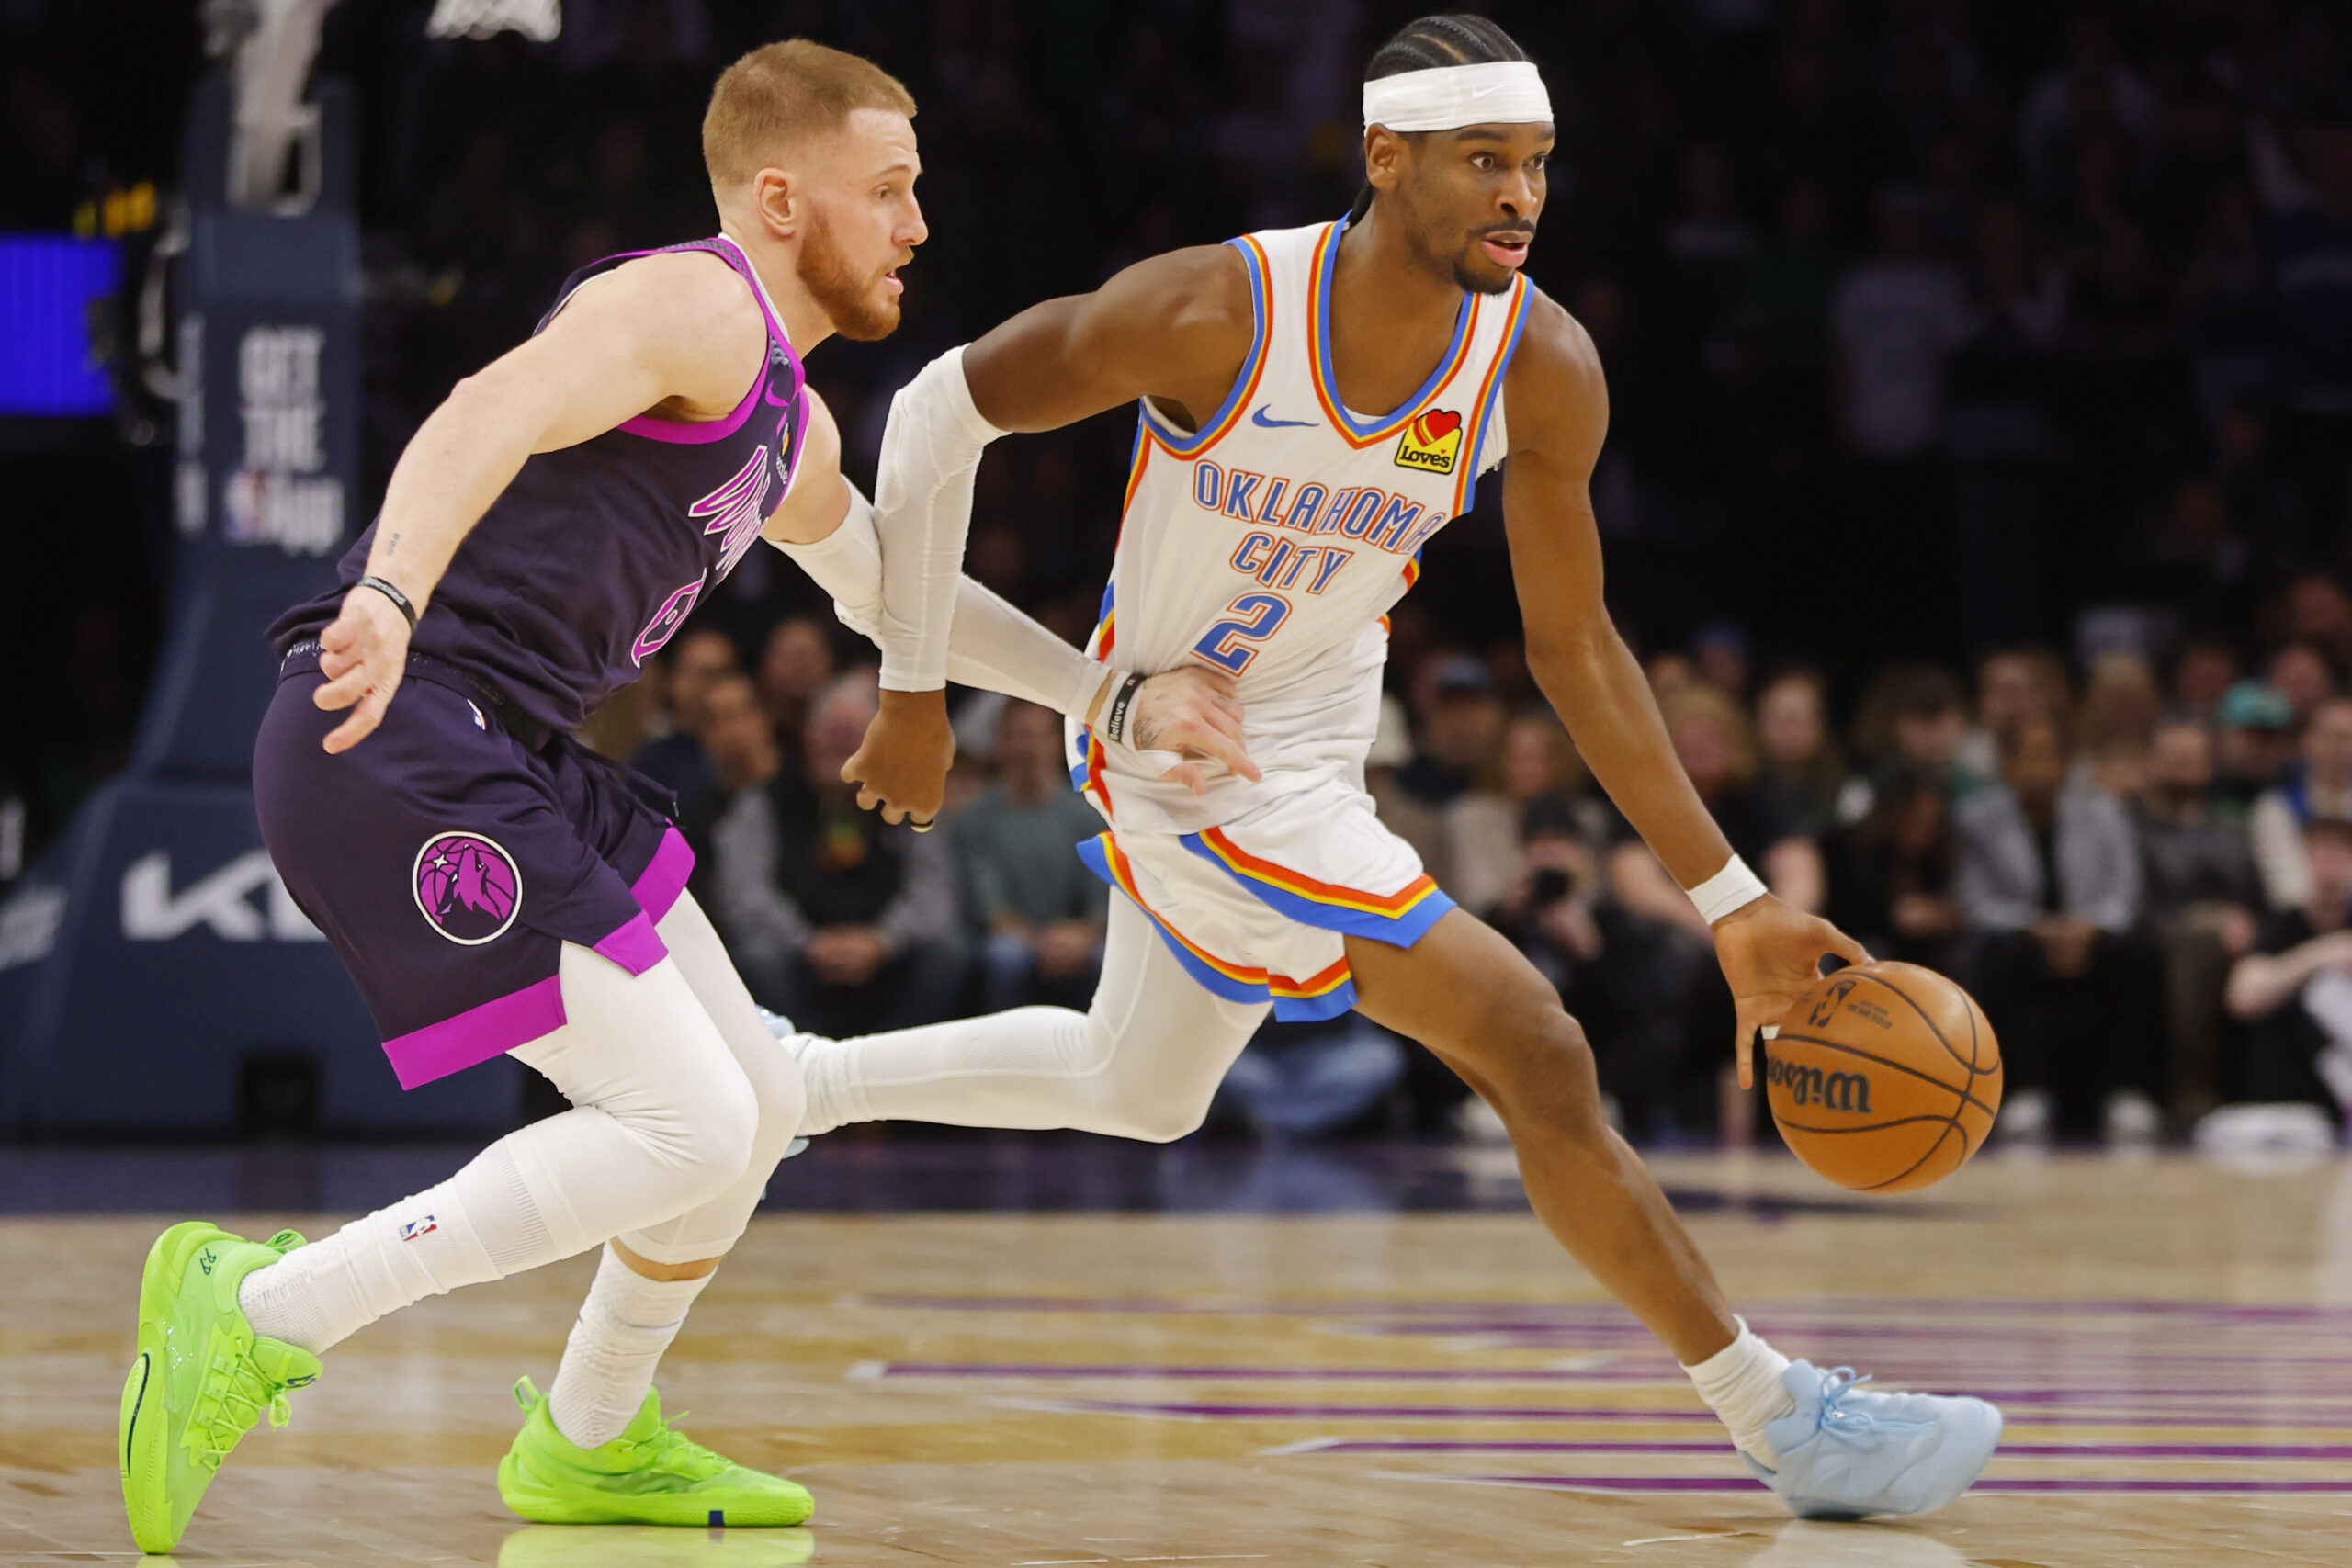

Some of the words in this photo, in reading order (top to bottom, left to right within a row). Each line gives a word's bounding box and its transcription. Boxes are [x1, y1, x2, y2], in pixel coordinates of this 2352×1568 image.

[1193, 459, 1447, 554] OKLAHOMA
[1229, 531, 1354, 595] CITY
[1188, 591, 1294, 678] 2
[1109, 701, 1125, 741] Believe
